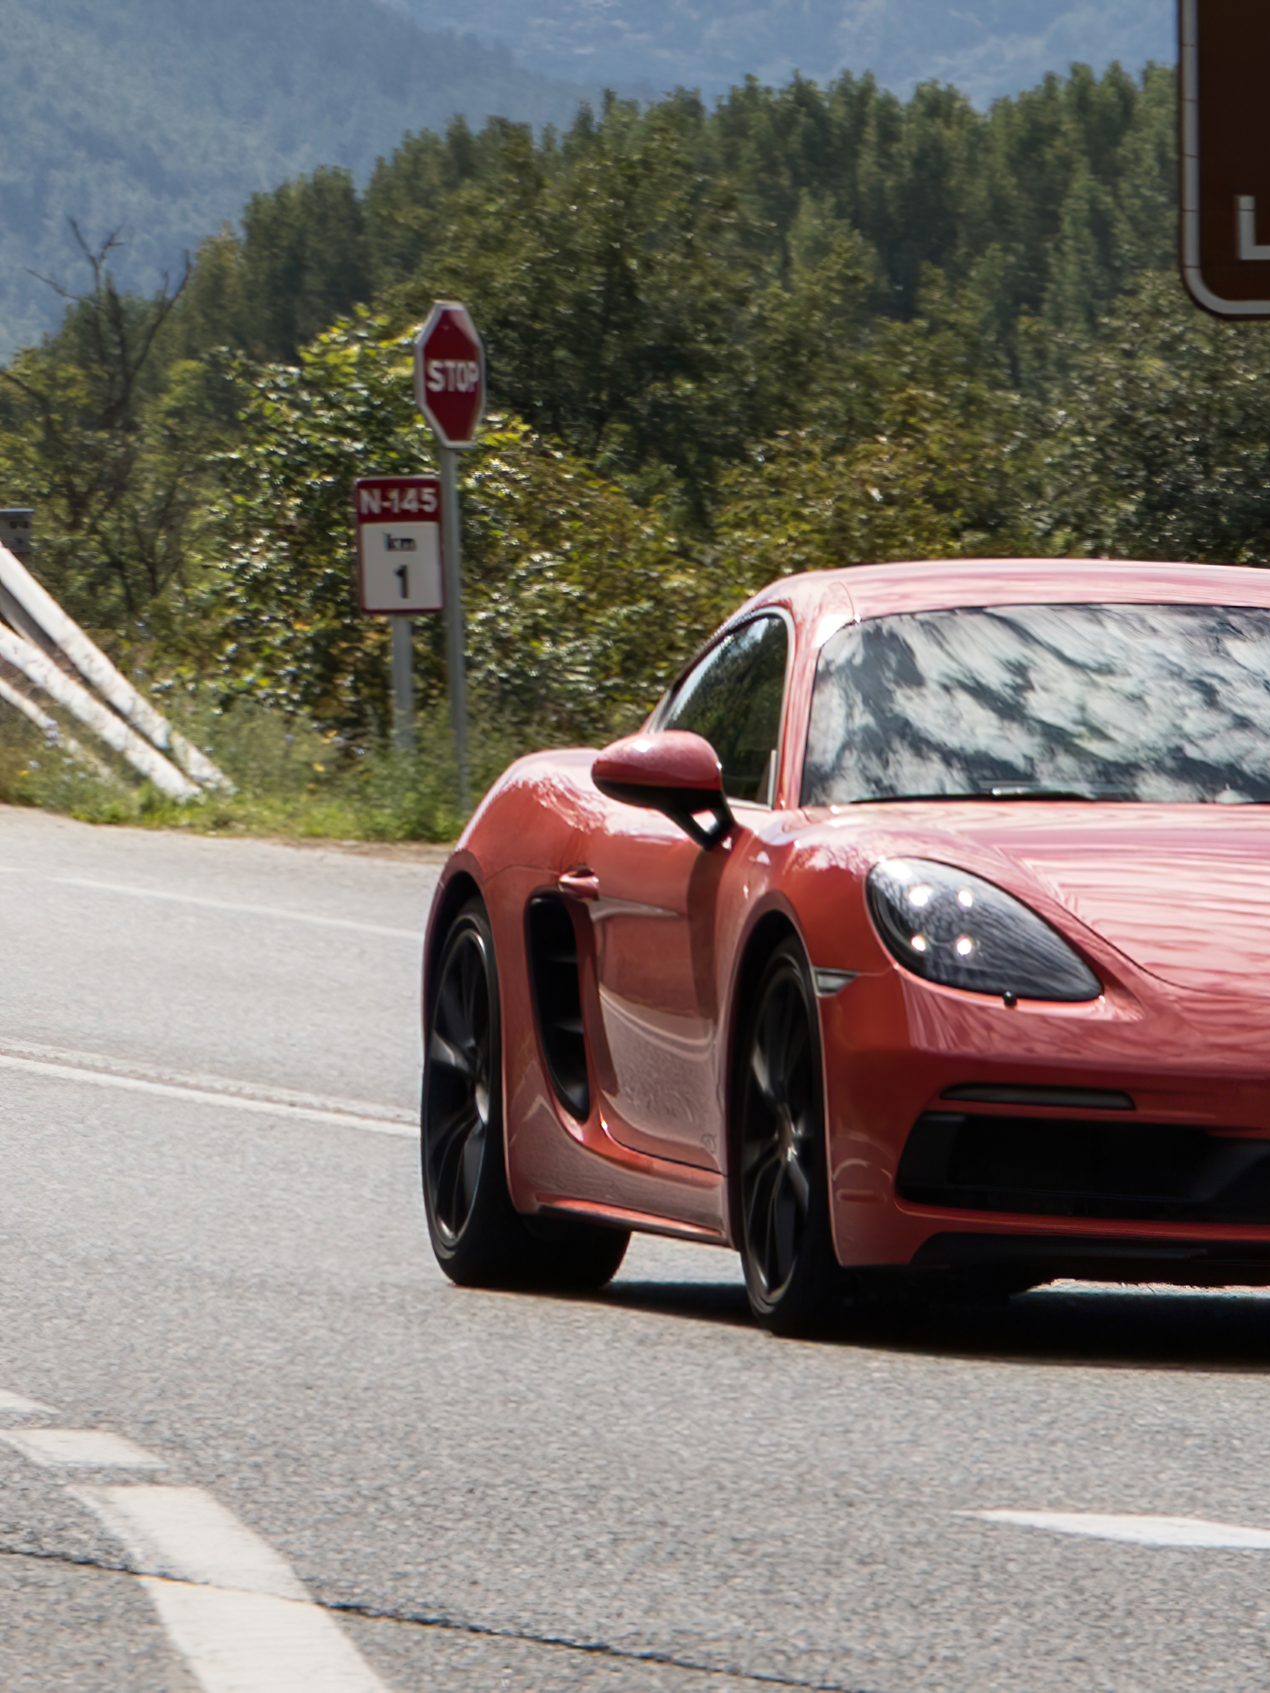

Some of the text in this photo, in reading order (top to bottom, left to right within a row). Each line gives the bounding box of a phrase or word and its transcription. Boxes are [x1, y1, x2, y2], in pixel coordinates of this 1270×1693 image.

[426, 358, 481, 393] STOP
[359, 487, 438, 515] N-145
[383, 532, 417, 552] km
[394, 564, 409, 600] 1
